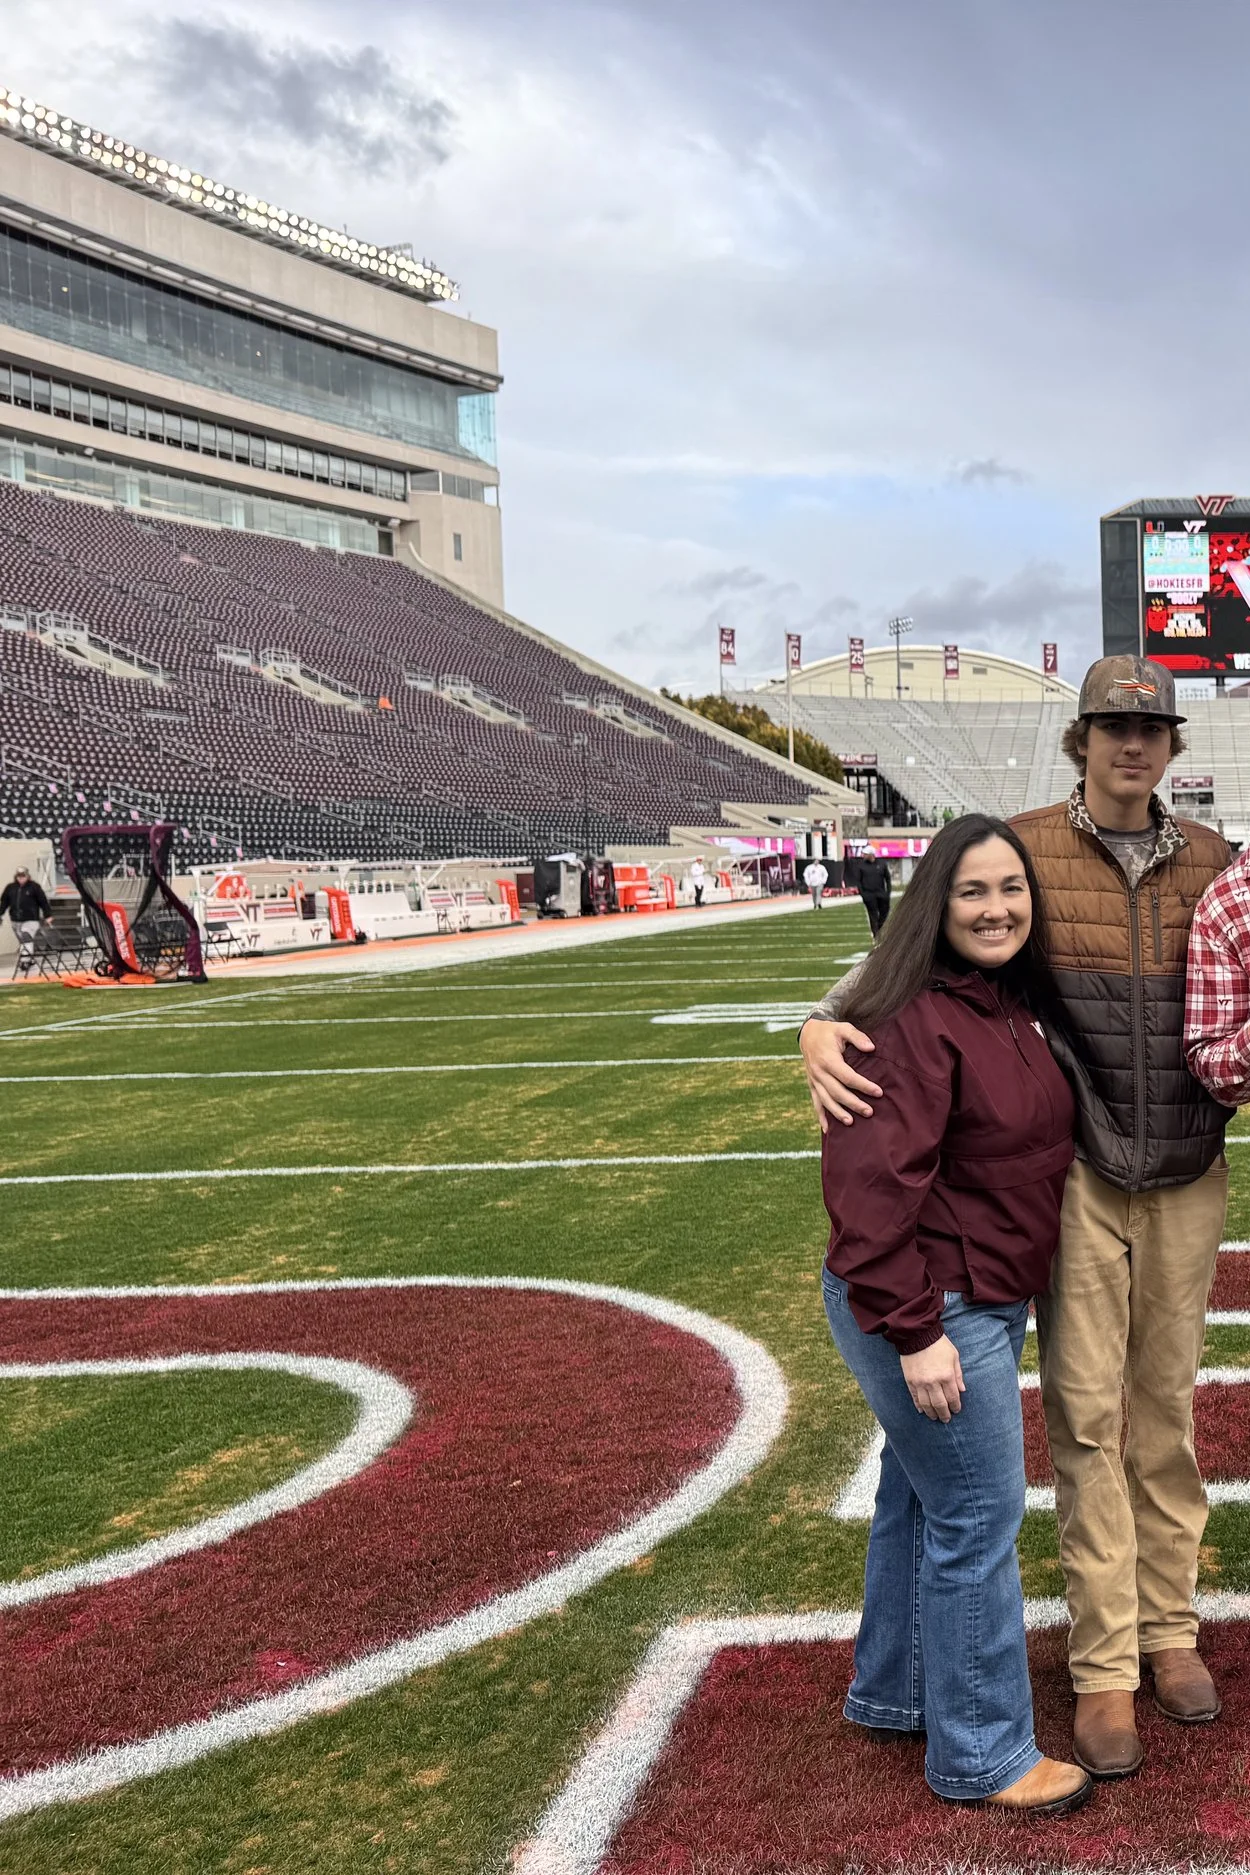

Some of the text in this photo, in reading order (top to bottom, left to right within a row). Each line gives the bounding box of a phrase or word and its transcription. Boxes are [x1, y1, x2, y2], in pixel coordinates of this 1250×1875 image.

[1195, 495, 1235, 516] VT
[1183, 520, 1207, 533] VT
[721, 641, 734, 655] 84
[851, 651, 864, 664] 25
[1046, 656, 1054, 668] 7
[310, 928, 323, 941] VT
